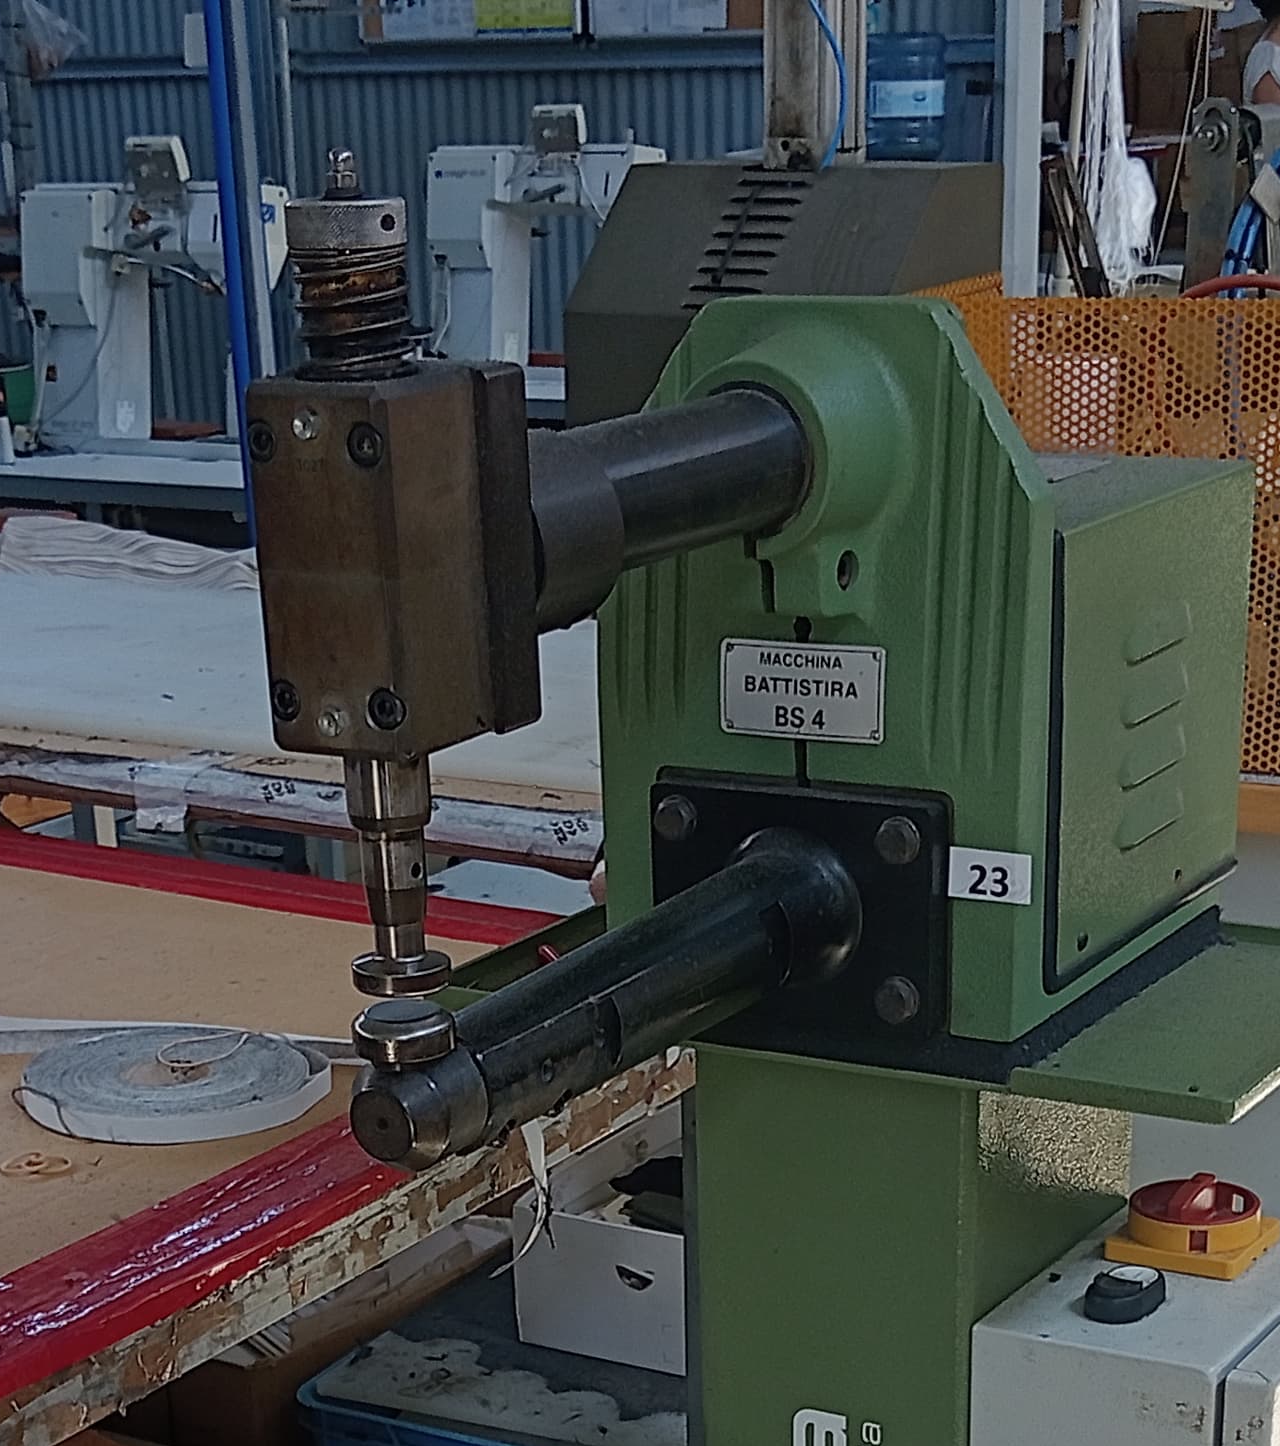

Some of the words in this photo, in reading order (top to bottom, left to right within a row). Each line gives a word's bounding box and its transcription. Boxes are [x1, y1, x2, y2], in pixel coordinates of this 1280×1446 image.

[759, 652, 842, 669] MACCHINA
[744, 675, 858, 699] BATTISTIRA
[775, 705, 805, 729] BS
[811, 709, 826, 730] 4
[968, 864, 1009, 897] 23
